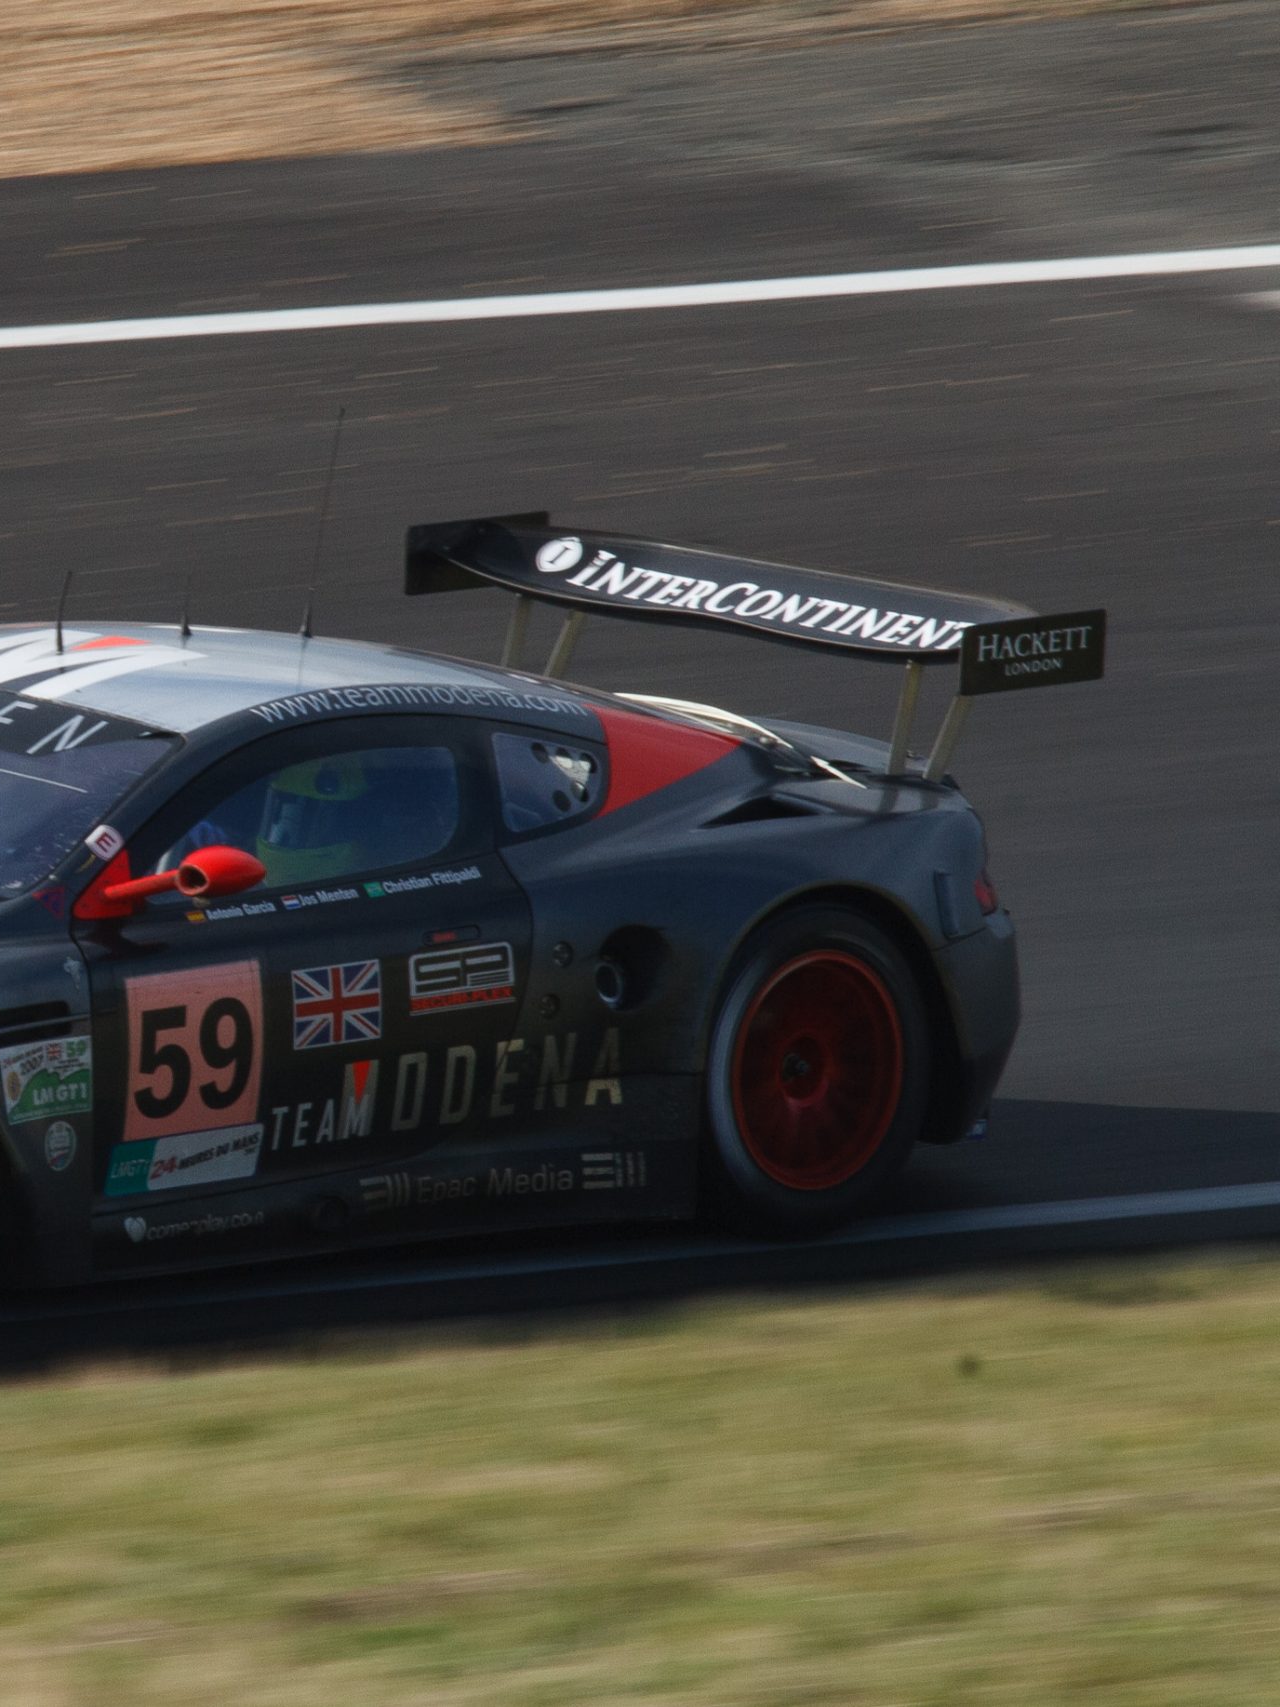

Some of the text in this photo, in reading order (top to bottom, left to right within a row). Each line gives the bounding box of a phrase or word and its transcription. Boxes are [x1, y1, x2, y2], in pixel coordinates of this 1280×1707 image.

[977, 625, 1092, 662] HACKETT
[1004, 657, 1062, 677] LONDON
[250, 683, 588, 724] www.teammodena.com
[299, 888, 360, 906] Jos Menten
[382, 866, 483, 894] Christian Fittipaldi
[134, 996, 254, 1119] 59
[271, 1094, 370, 1151] TEAM
[150, 1154, 178, 1180] 24
[486, 1161, 576, 1197] Media
